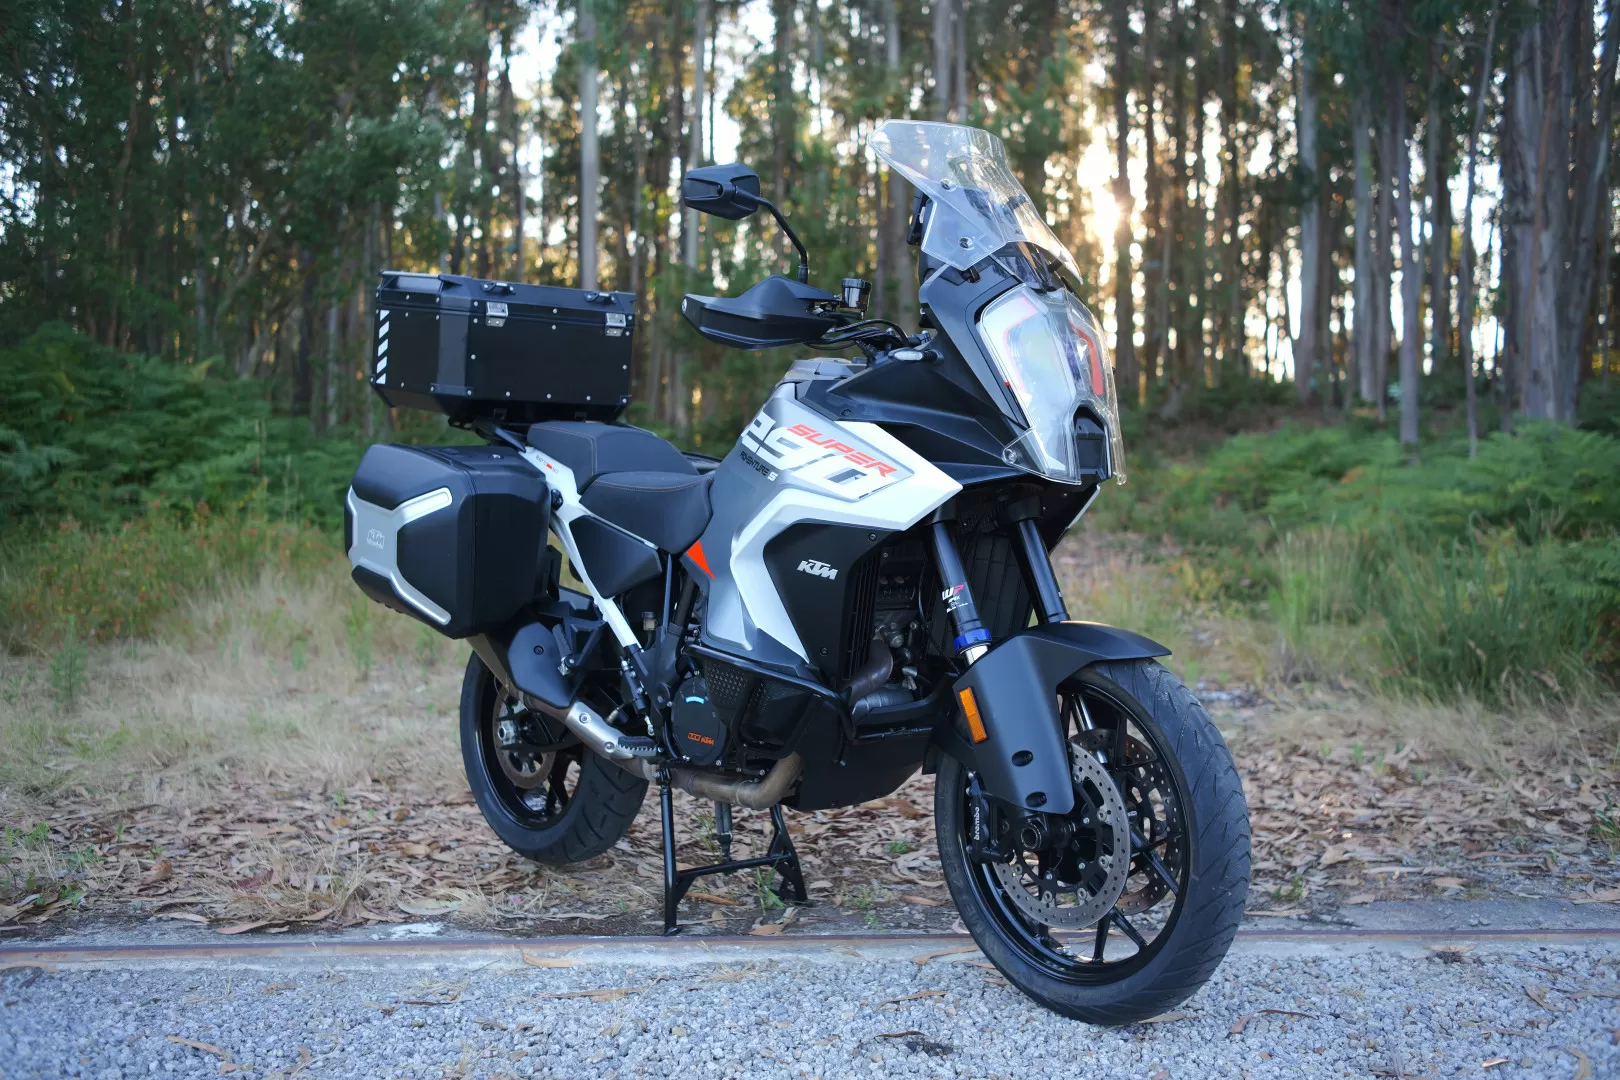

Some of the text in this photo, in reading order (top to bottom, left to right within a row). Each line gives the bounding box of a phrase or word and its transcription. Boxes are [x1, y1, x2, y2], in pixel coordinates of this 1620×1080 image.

[786, 423, 897, 478] SUPER
[740, 450, 779, 482] ADVENTURE S
[797, 559, 838, 580] KTM
[942, 584, 964, 600] WP
